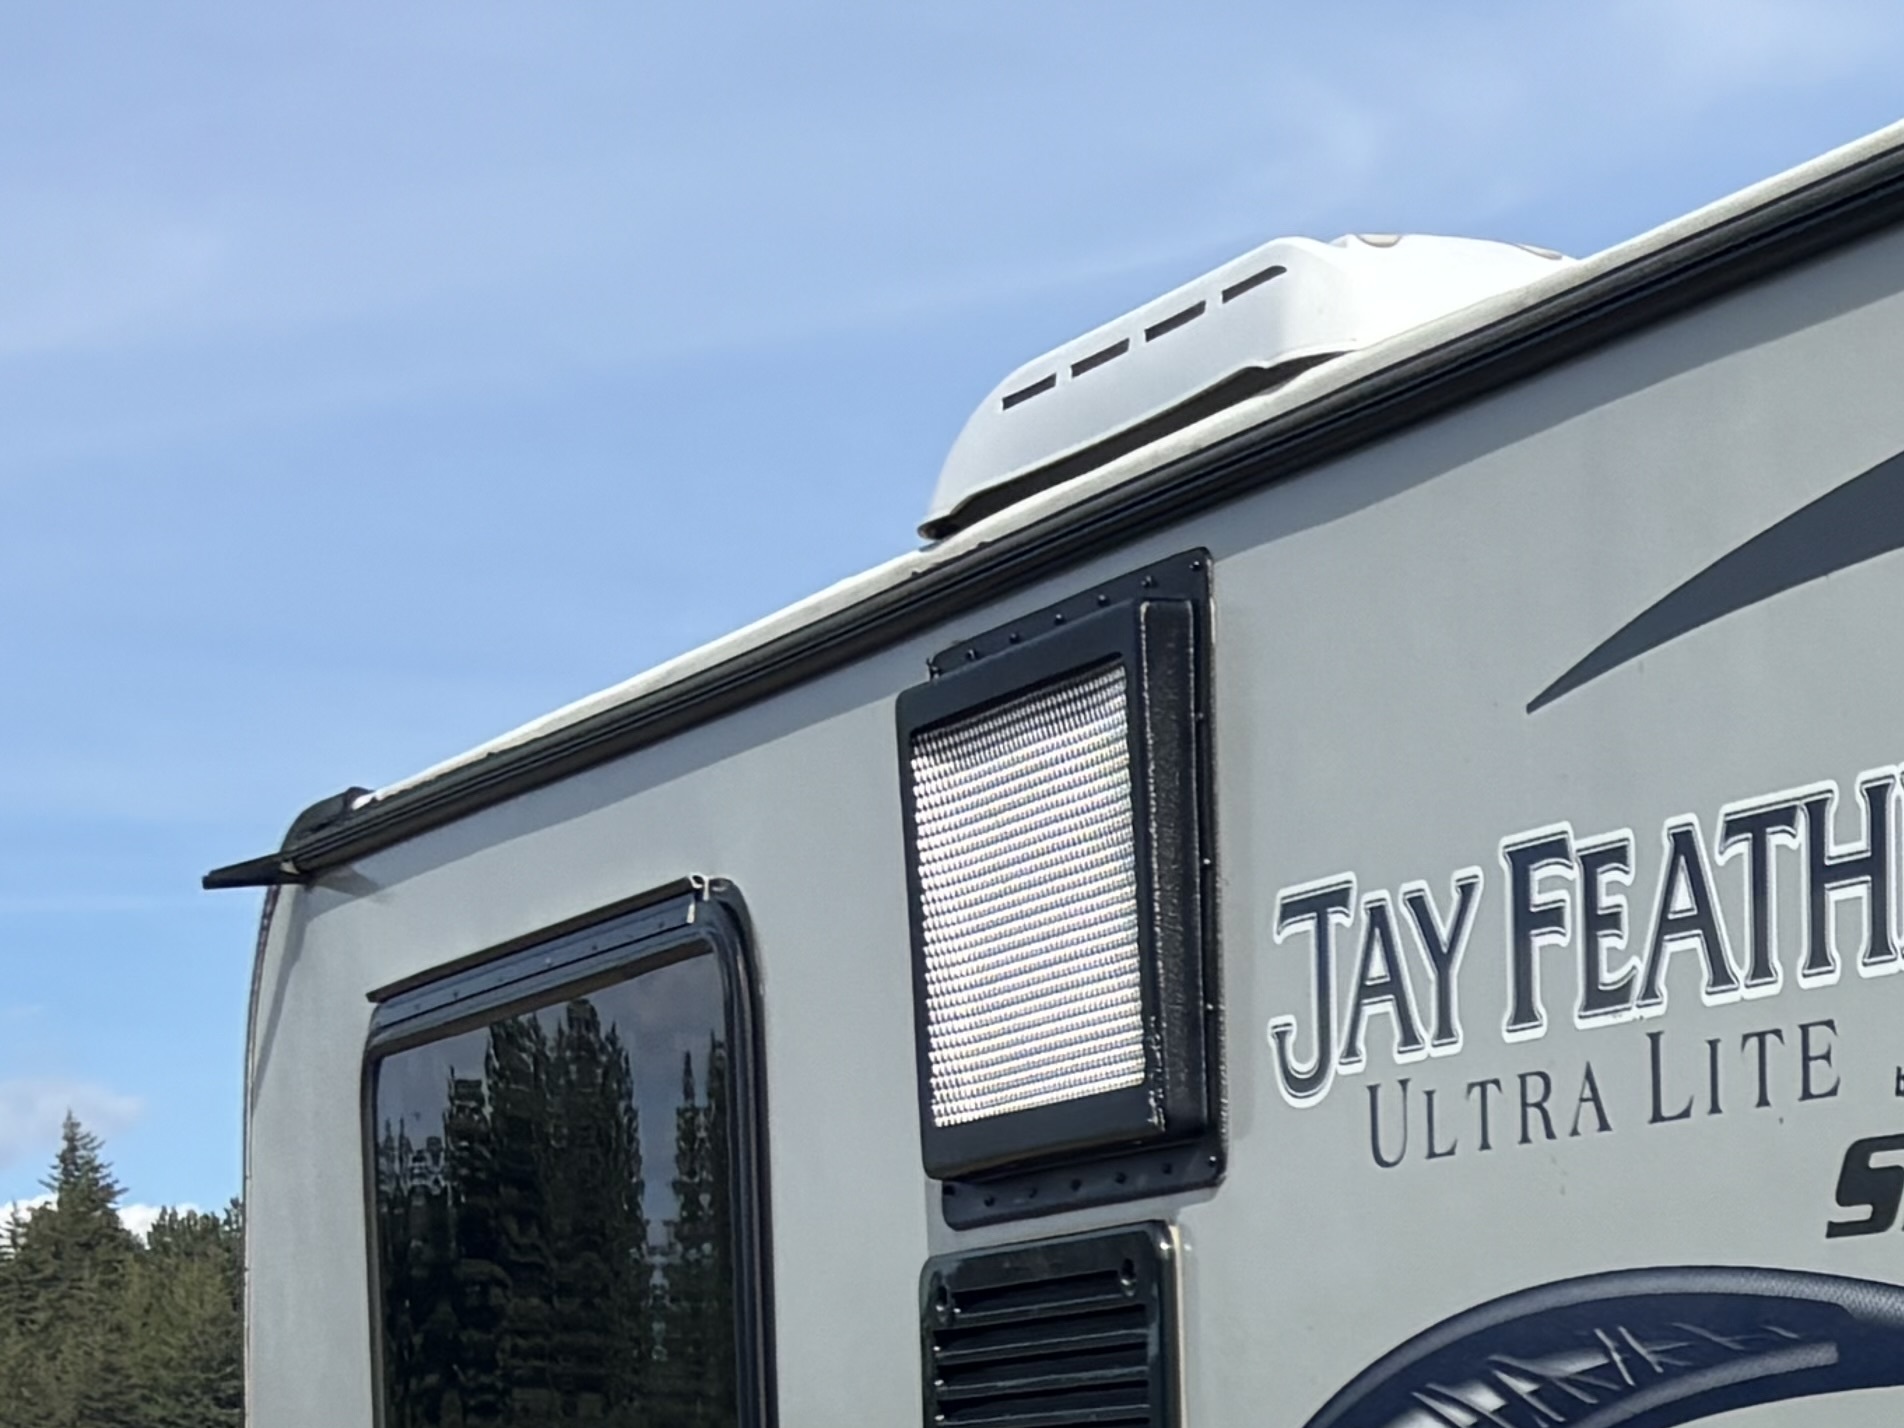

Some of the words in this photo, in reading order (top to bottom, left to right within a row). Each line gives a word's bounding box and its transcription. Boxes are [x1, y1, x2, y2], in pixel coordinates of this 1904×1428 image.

[1269, 866, 1483, 1108] JAY
[1367, 1060, 1612, 1169] ULTRA
[1646, 1017, 1841, 1124] LITE
